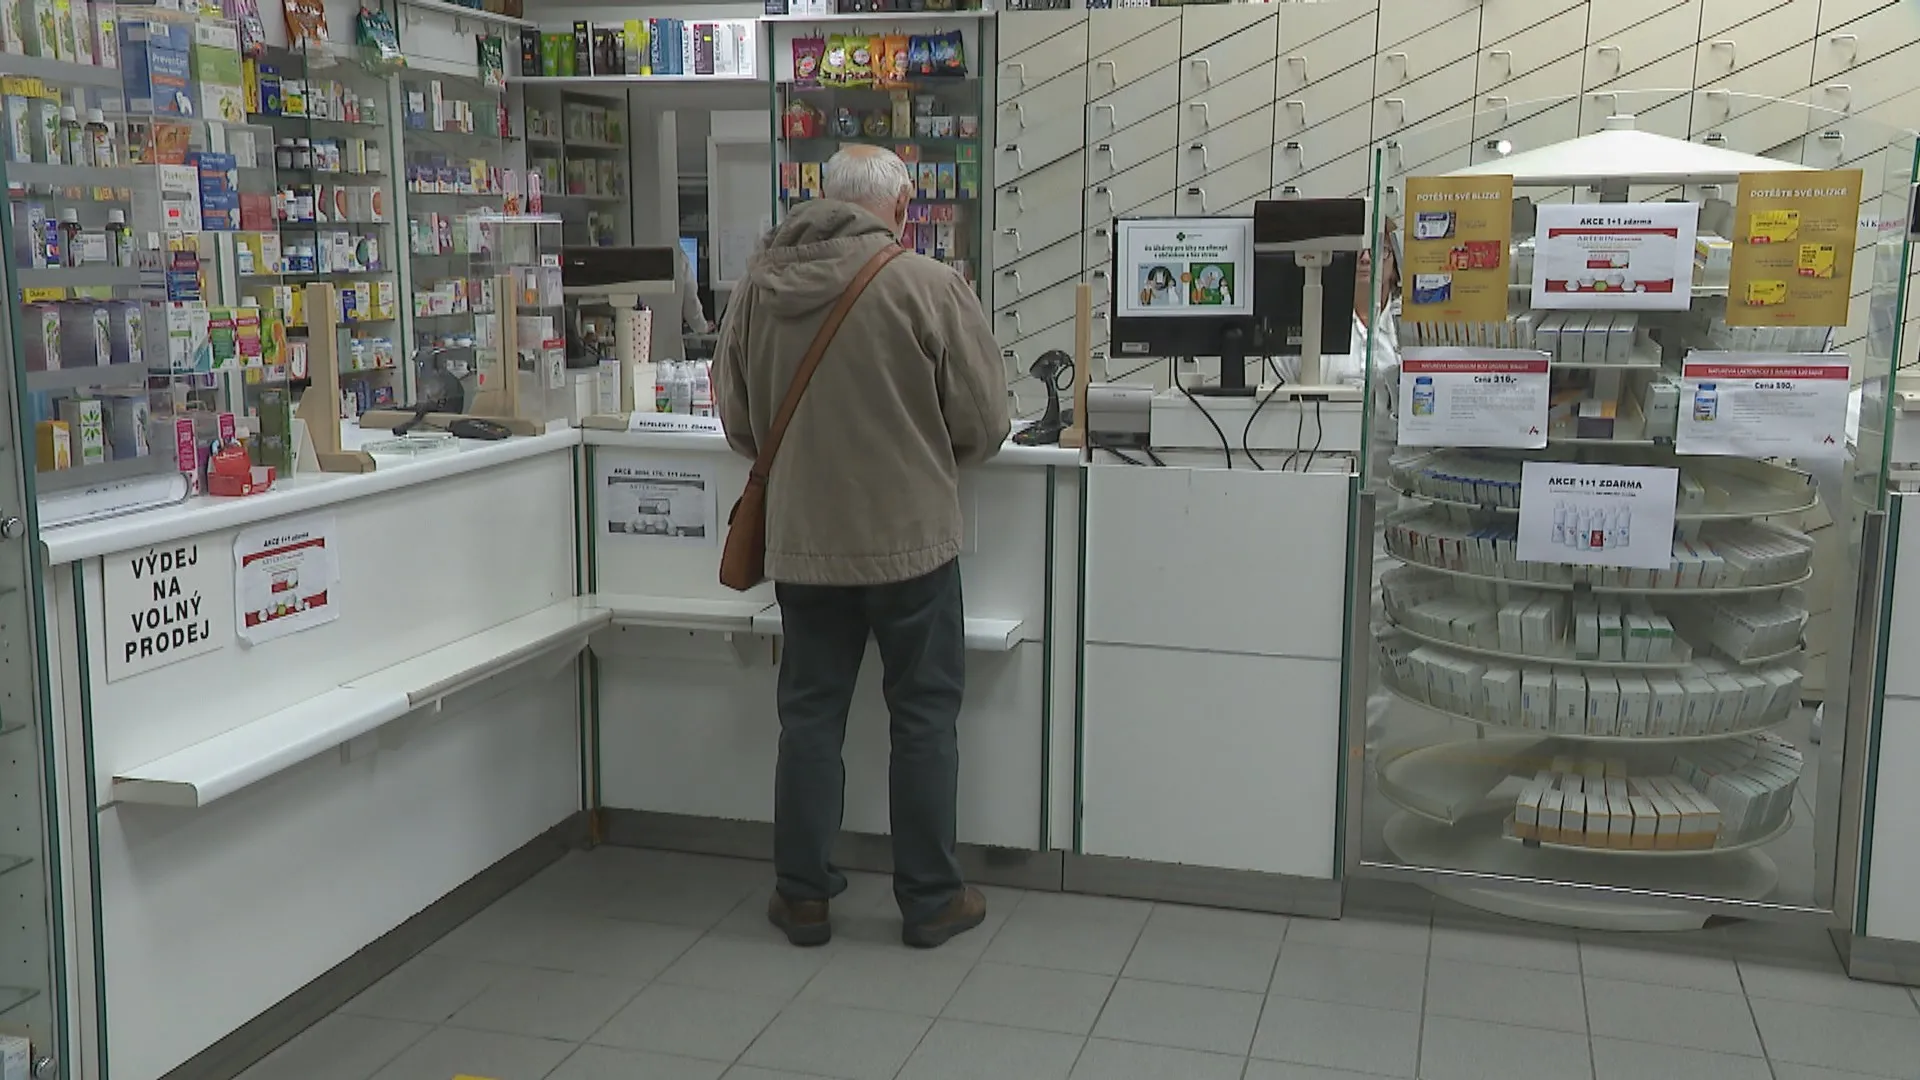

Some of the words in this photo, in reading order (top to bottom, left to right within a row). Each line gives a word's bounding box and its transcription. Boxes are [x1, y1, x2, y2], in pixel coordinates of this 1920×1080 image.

[1580, 217, 1604, 226] AKCE
[1607, 217, 1621, 226] 1+1
[1623, 218, 1652, 226] zdarma
[1474, 376, 1492, 384] Cena
[1755, 382, 1774, 390] Cena
[1549, 477, 1576, 486] AKCE
[1579, 478, 1596, 487] 1+1
[1598, 479, 1643, 489] ZDARMA
[131, 544, 198, 579] VÝDEJ
[153, 576, 181, 601] NA
[131, 590, 202, 633] VOLNÝ
[125, 619, 209, 663] PRODEJ
